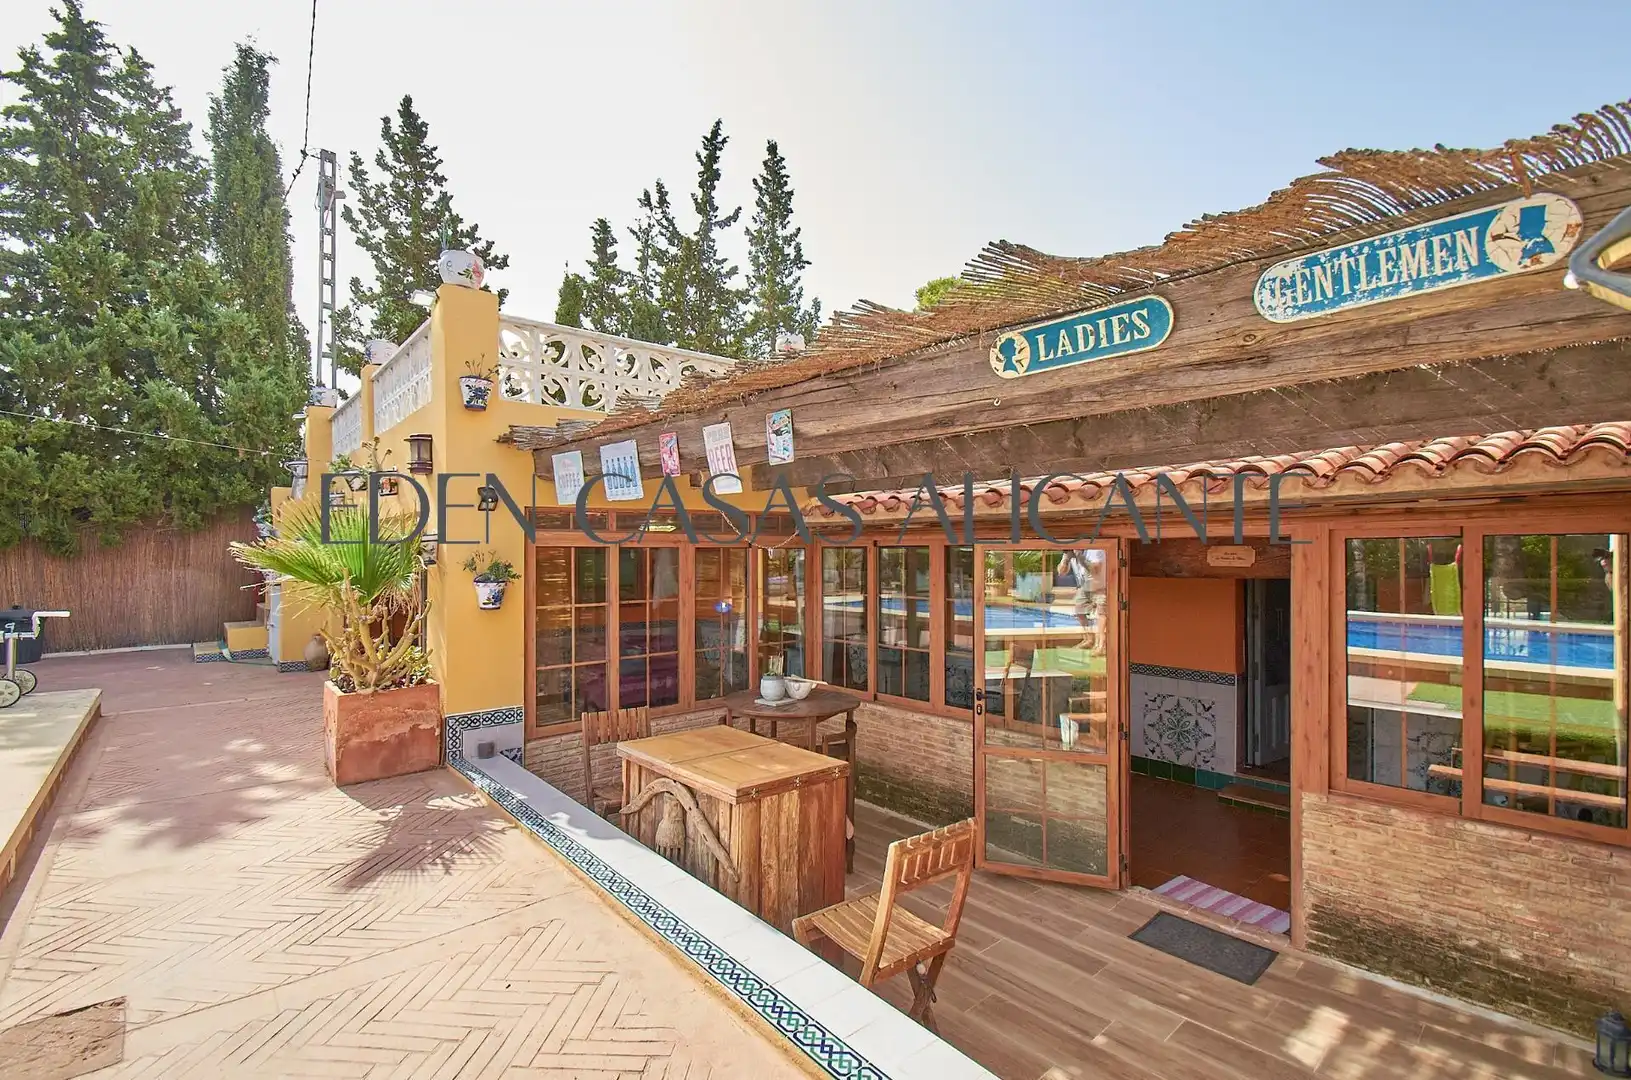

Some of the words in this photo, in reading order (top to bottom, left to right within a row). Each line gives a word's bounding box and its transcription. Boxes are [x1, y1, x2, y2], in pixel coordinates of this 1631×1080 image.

[1273, 226, 1480, 308] GENTLEMEN
[1036, 308, 1150, 361] LADIES
[707, 443, 735, 474] BEER
